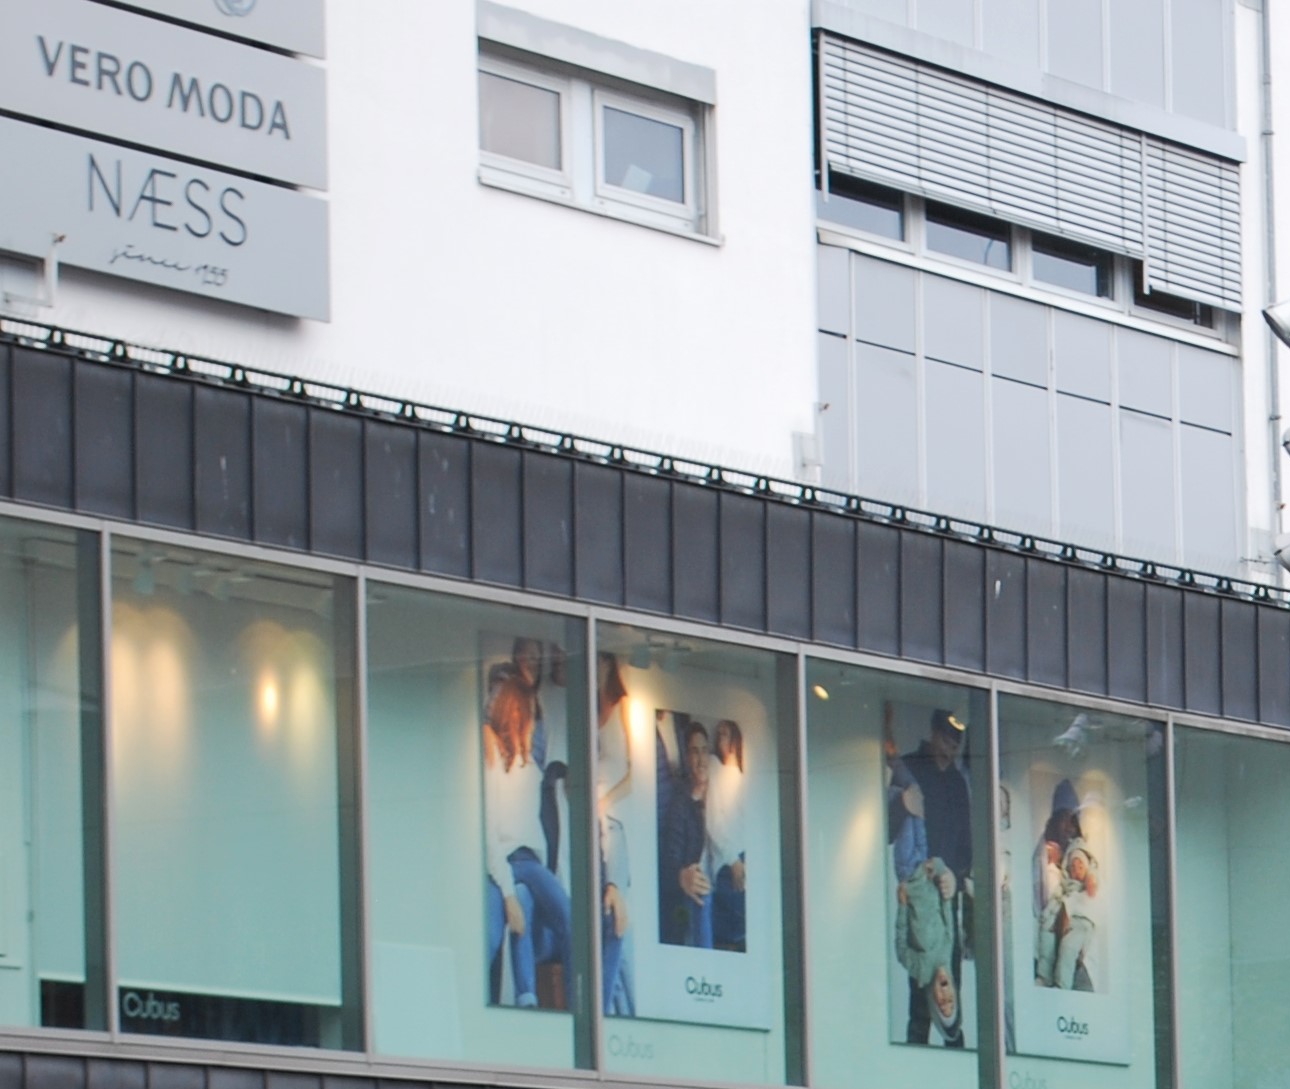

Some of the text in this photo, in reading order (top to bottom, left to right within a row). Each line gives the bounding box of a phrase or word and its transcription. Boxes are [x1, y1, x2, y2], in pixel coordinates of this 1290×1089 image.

[37, 35, 291, 140] VERO MODA
[88, 153, 247, 246] NÆSS
[685, 976, 723, 998] Cubus
[122, 992, 181, 1021] Cubus
[1056, 1015, 1089, 1035] Cubus
